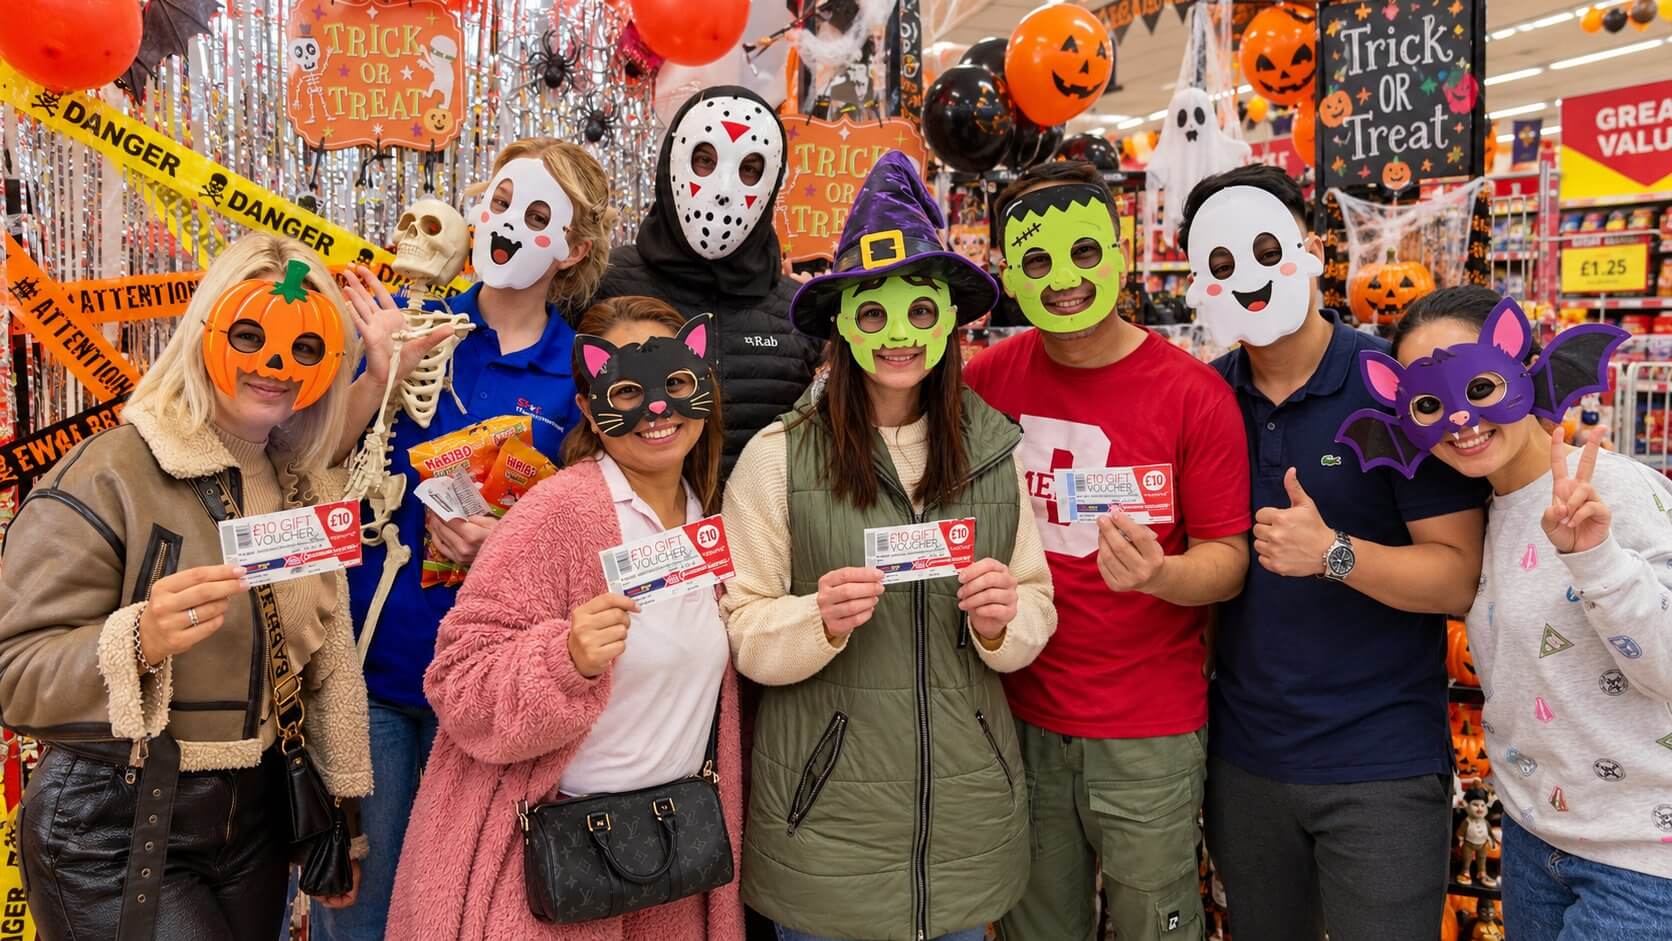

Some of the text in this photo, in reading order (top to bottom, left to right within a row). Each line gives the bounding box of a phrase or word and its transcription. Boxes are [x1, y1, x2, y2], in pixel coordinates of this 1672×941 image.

[324, 22, 424, 58] TRICK
[1340, 14, 1454, 76] Trick
[360, 62, 391, 85] OR
[328, 86, 426, 121] TREAT
[1379, 72, 1413, 113] OR
[62, 100, 181, 178] DANGER
[1343, 104, 1449, 161] Treat
[825, 182, 855, 204] OR
[227, 190, 335, 257] DANGER
[1580, 259, 1627, 277] £1.25
[754, 336, 778, 347] Rab
[1087, 483, 1133, 493] VOUCHER
[1105, 472, 1129, 484] GIFT
[1145, 474, 1163, 486] £10
[253, 515, 312, 537] £10 GIFT
[331, 511, 350, 527] £10
[254, 527, 315, 546] VOUCHER
[699, 528, 717, 544] £10
[890, 528, 937, 544] £10 GIFT
[951, 527, 967, 540] £10
[630, 545, 653, 561] £10
[655, 534, 683, 554] GIFT
[890, 538, 938, 552] VOUCHER
[633, 545, 688, 570] VOUCHER
[1, 888, 27, 941] GER
